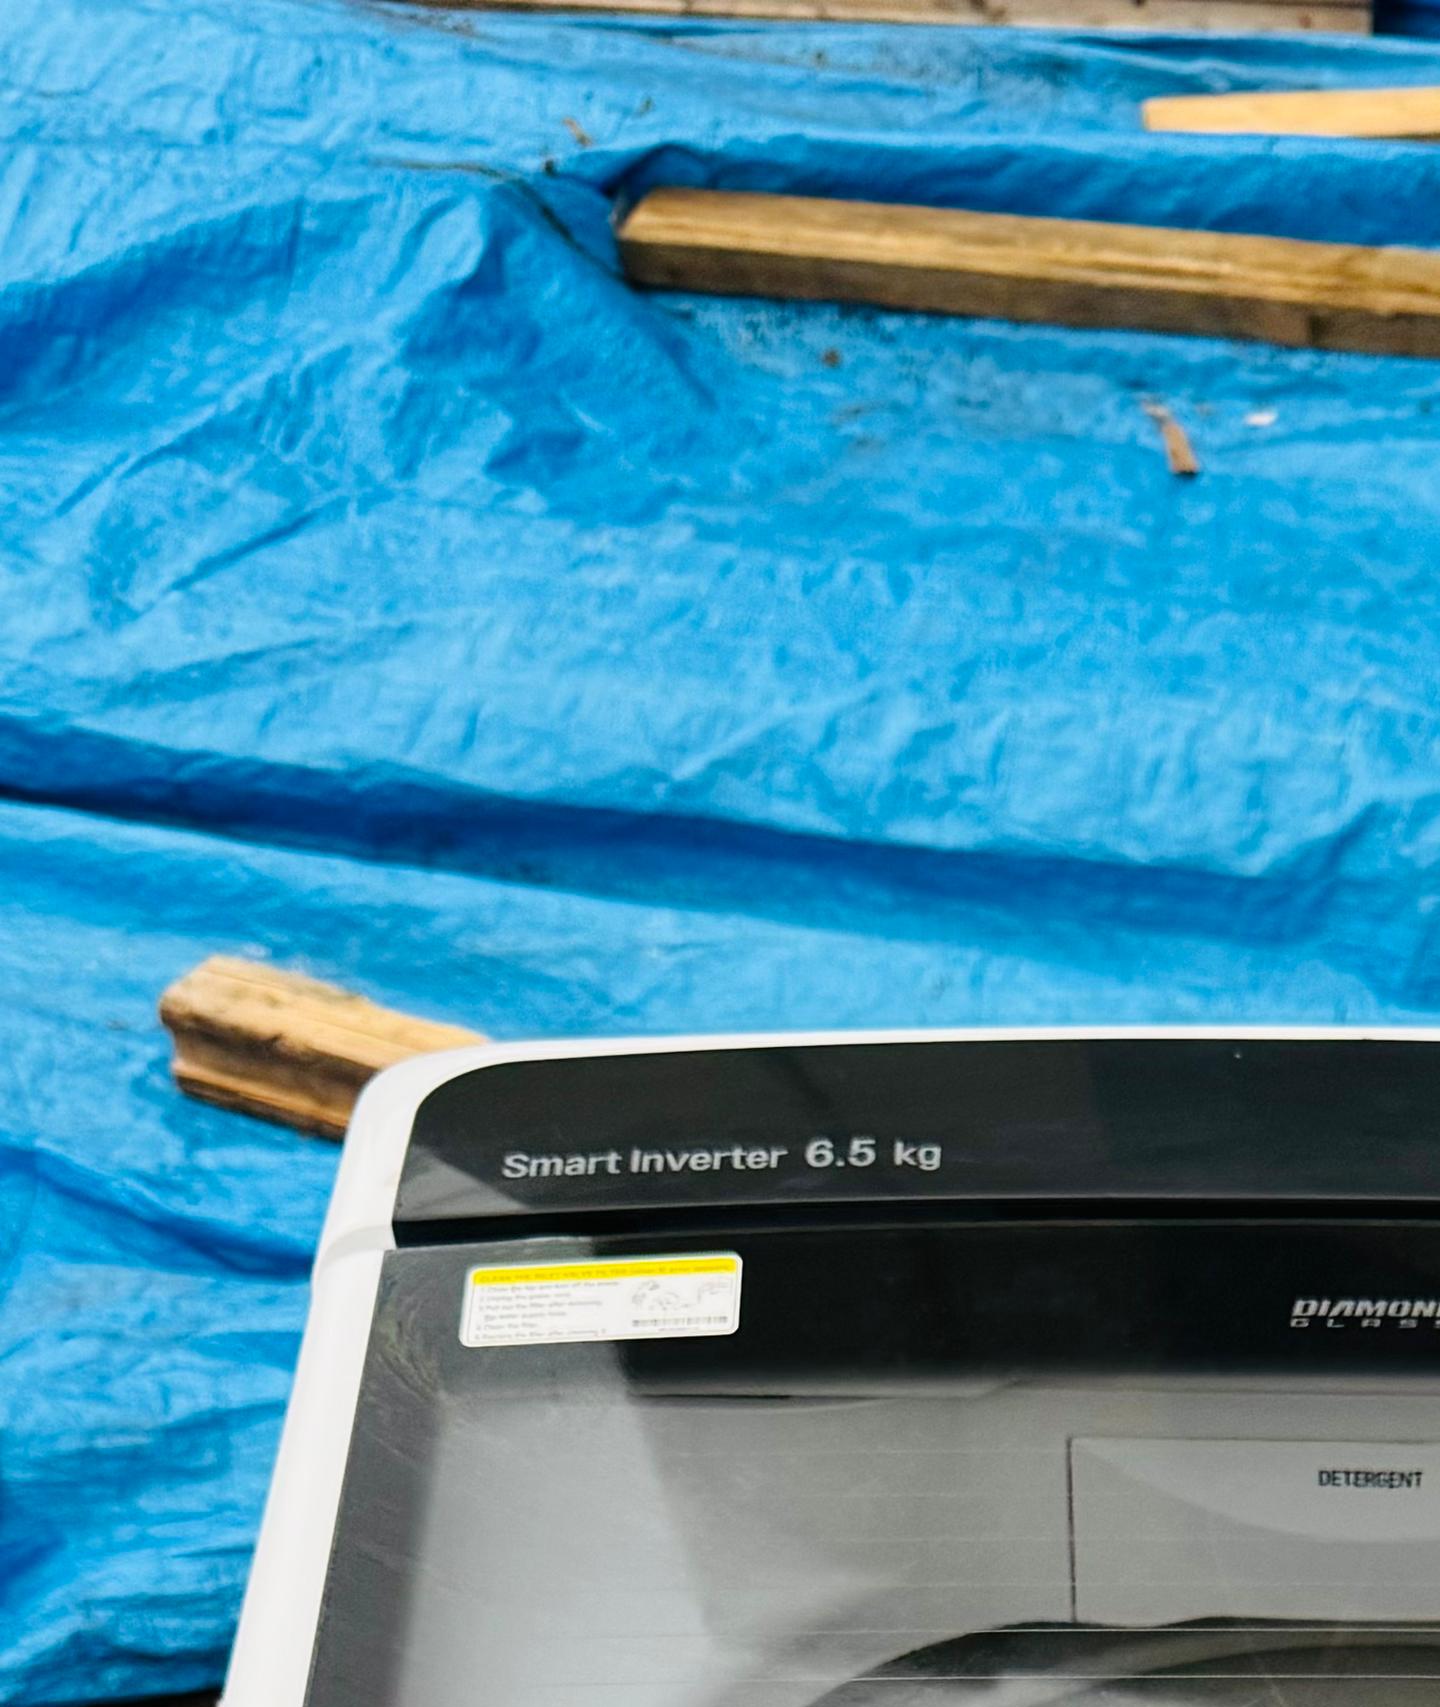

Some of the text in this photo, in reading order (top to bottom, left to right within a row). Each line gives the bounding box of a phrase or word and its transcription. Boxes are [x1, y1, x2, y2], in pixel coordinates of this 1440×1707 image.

[502, 1138, 941, 1179] Smart Inverter 6.5 kg
[1318, 1470, 1423, 1488] DETERGENT
